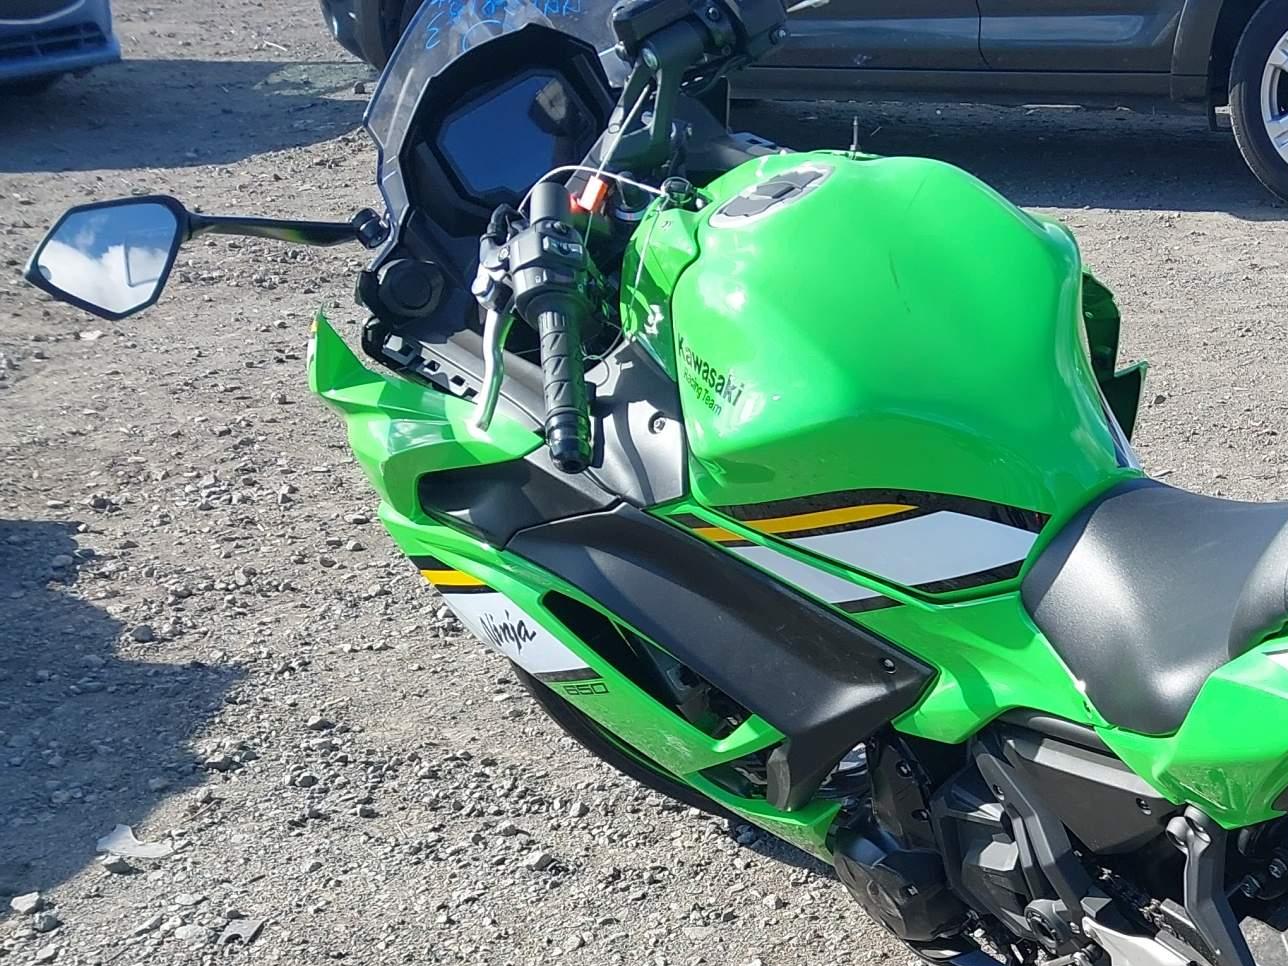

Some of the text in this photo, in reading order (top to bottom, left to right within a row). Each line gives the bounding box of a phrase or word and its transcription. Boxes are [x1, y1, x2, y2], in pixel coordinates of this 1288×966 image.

[678, 332, 745, 406] Kawasaki
[683, 366, 722, 416] Racing Team
[479, 608, 537, 655] Ninja
[563, 682, 610, 696] 650
